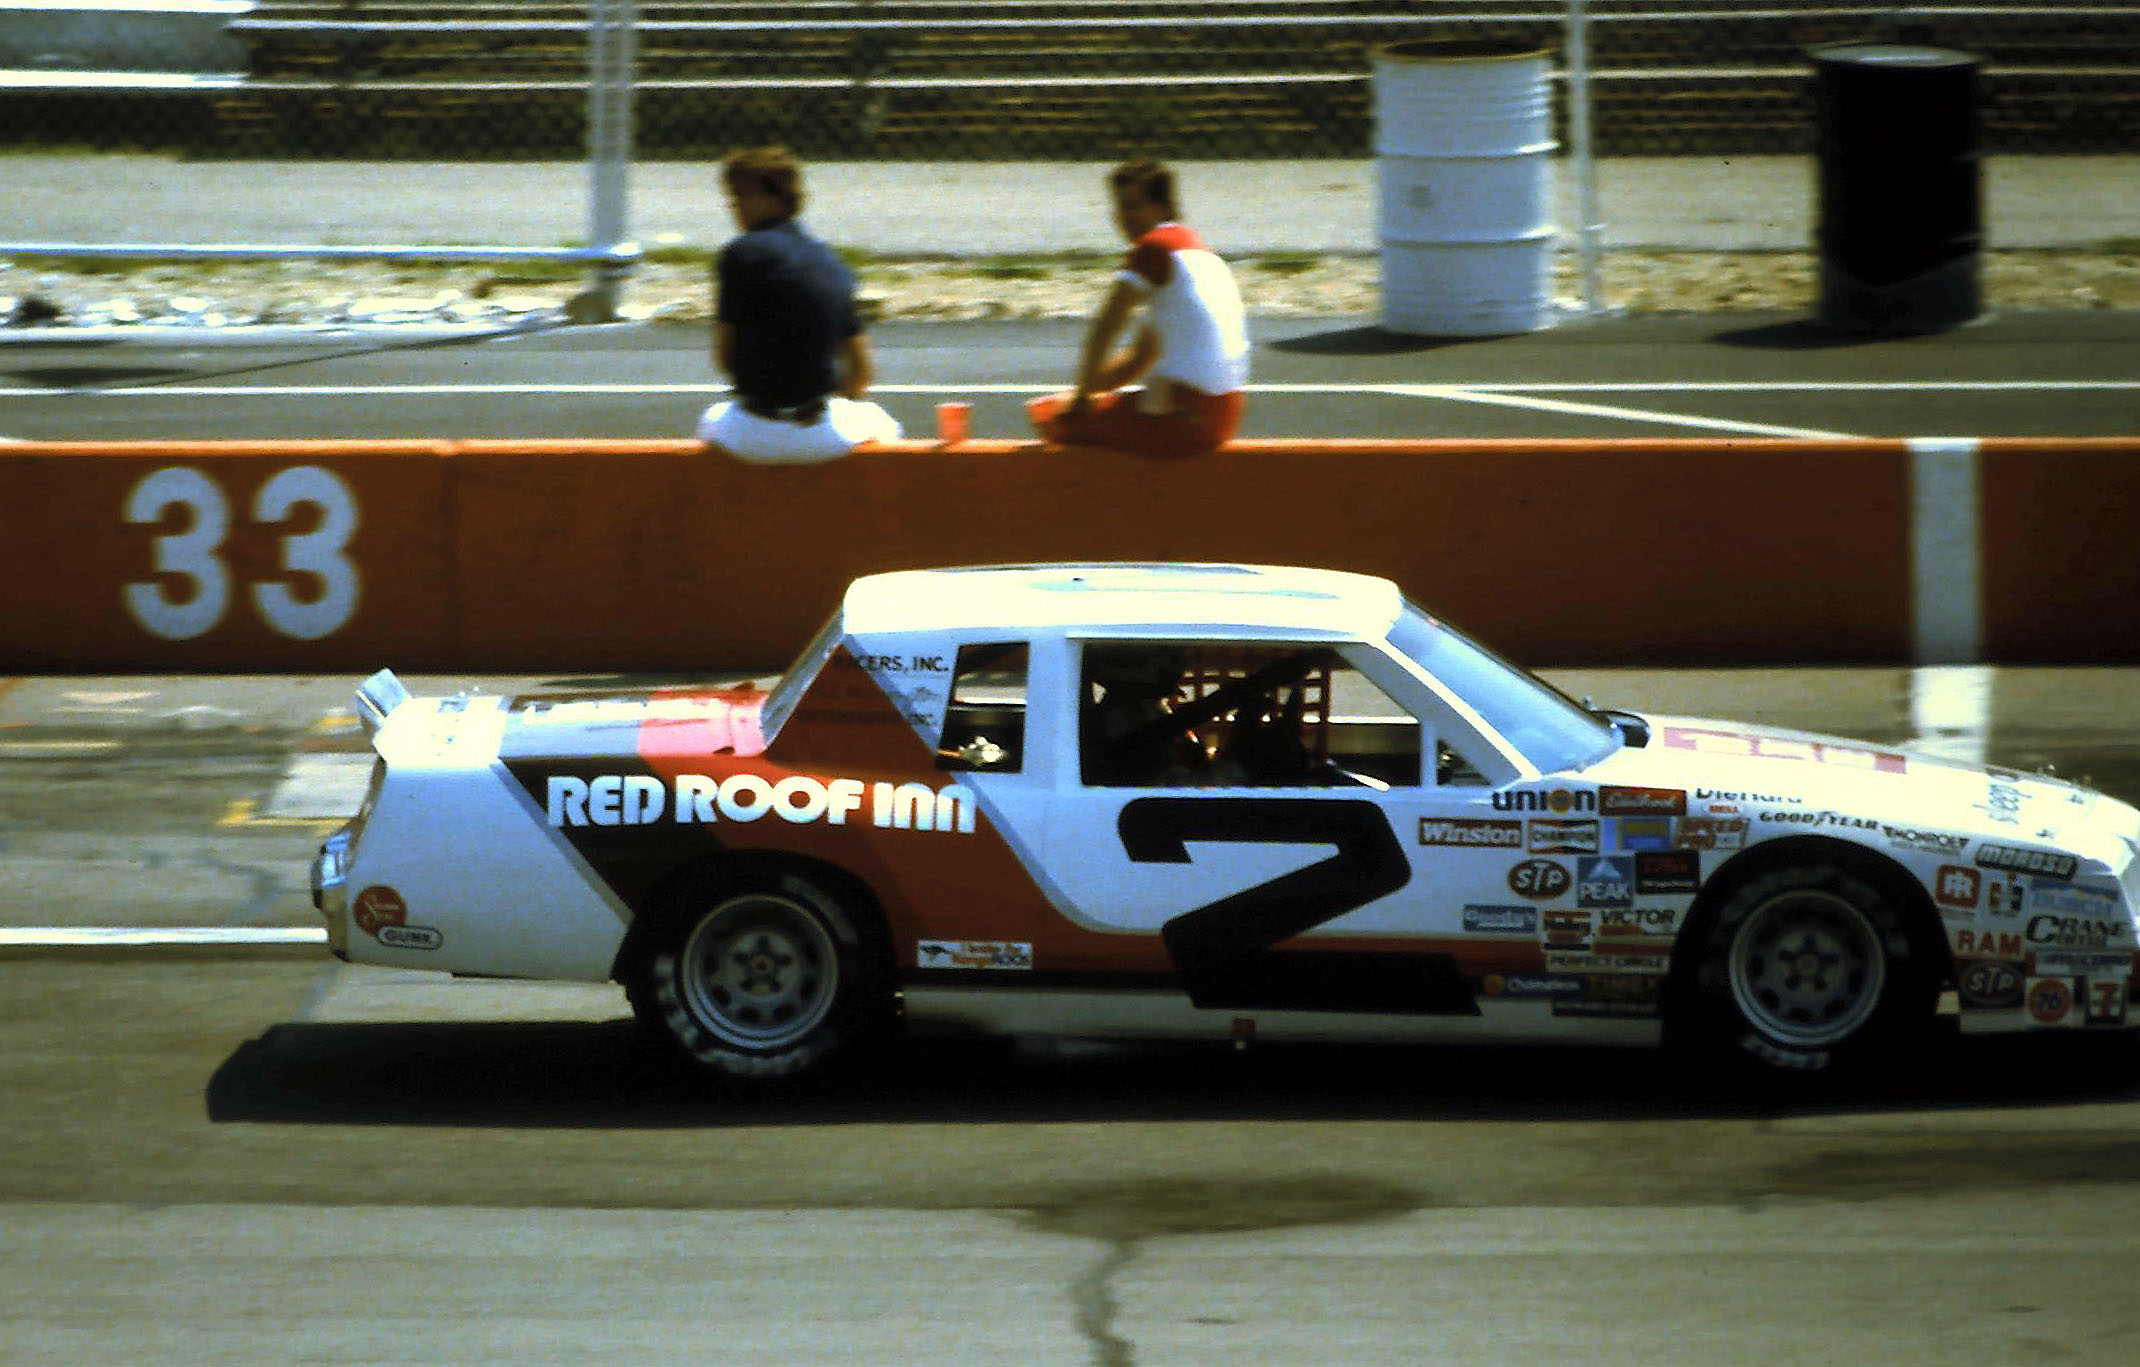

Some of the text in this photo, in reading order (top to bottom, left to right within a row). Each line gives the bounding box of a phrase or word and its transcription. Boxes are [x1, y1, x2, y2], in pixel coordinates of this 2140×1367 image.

[124, 466, 360, 640] 33
[913, 656, 949, 673] INC.
[547, 775, 665, 828] RED
[675, 774, 865, 825] ROOF
[1424, 822, 1519, 843] Winston
[1759, 811, 1879, 830] GOODYEAR
[1516, 862, 1565, 892] STP
[1579, 882, 1629, 899] PEAK
[1117, 797, 1483, 1016] 2
[1601, 909, 1675, 924] VICTOR
[1956, 929, 2021, 954] RAM
[1968, 966, 2015, 993] STP
